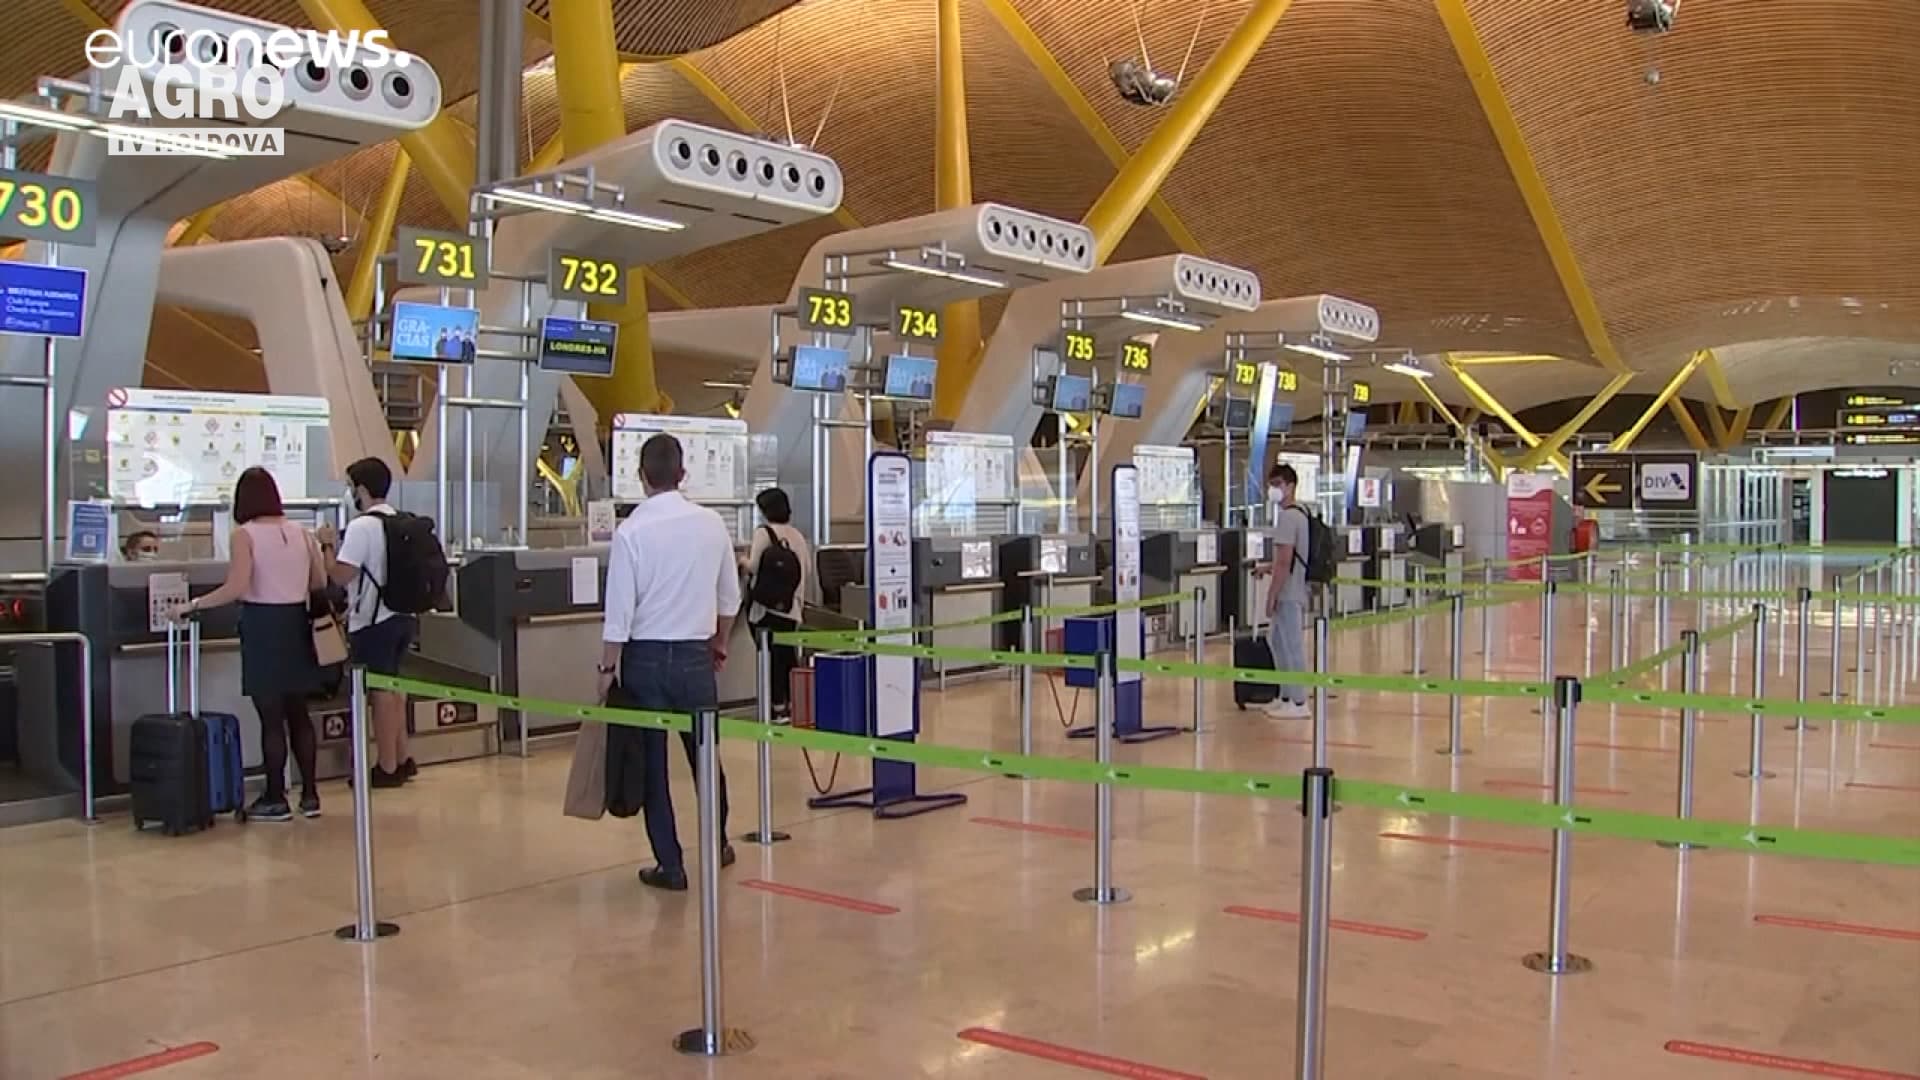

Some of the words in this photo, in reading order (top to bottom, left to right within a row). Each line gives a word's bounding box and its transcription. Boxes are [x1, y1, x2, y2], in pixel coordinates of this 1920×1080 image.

[415, 239, 476, 279] 731
[560, 257, 618, 295] 732
[808, 296, 851, 327] 733
[900, 308, 938, 339] 734
[396, 332, 431, 347] CIAS
[1066, 335, 1094, 361] 735
[1123, 344, 1149, 369] 736
[1235, 363, 1256, 385] 737
